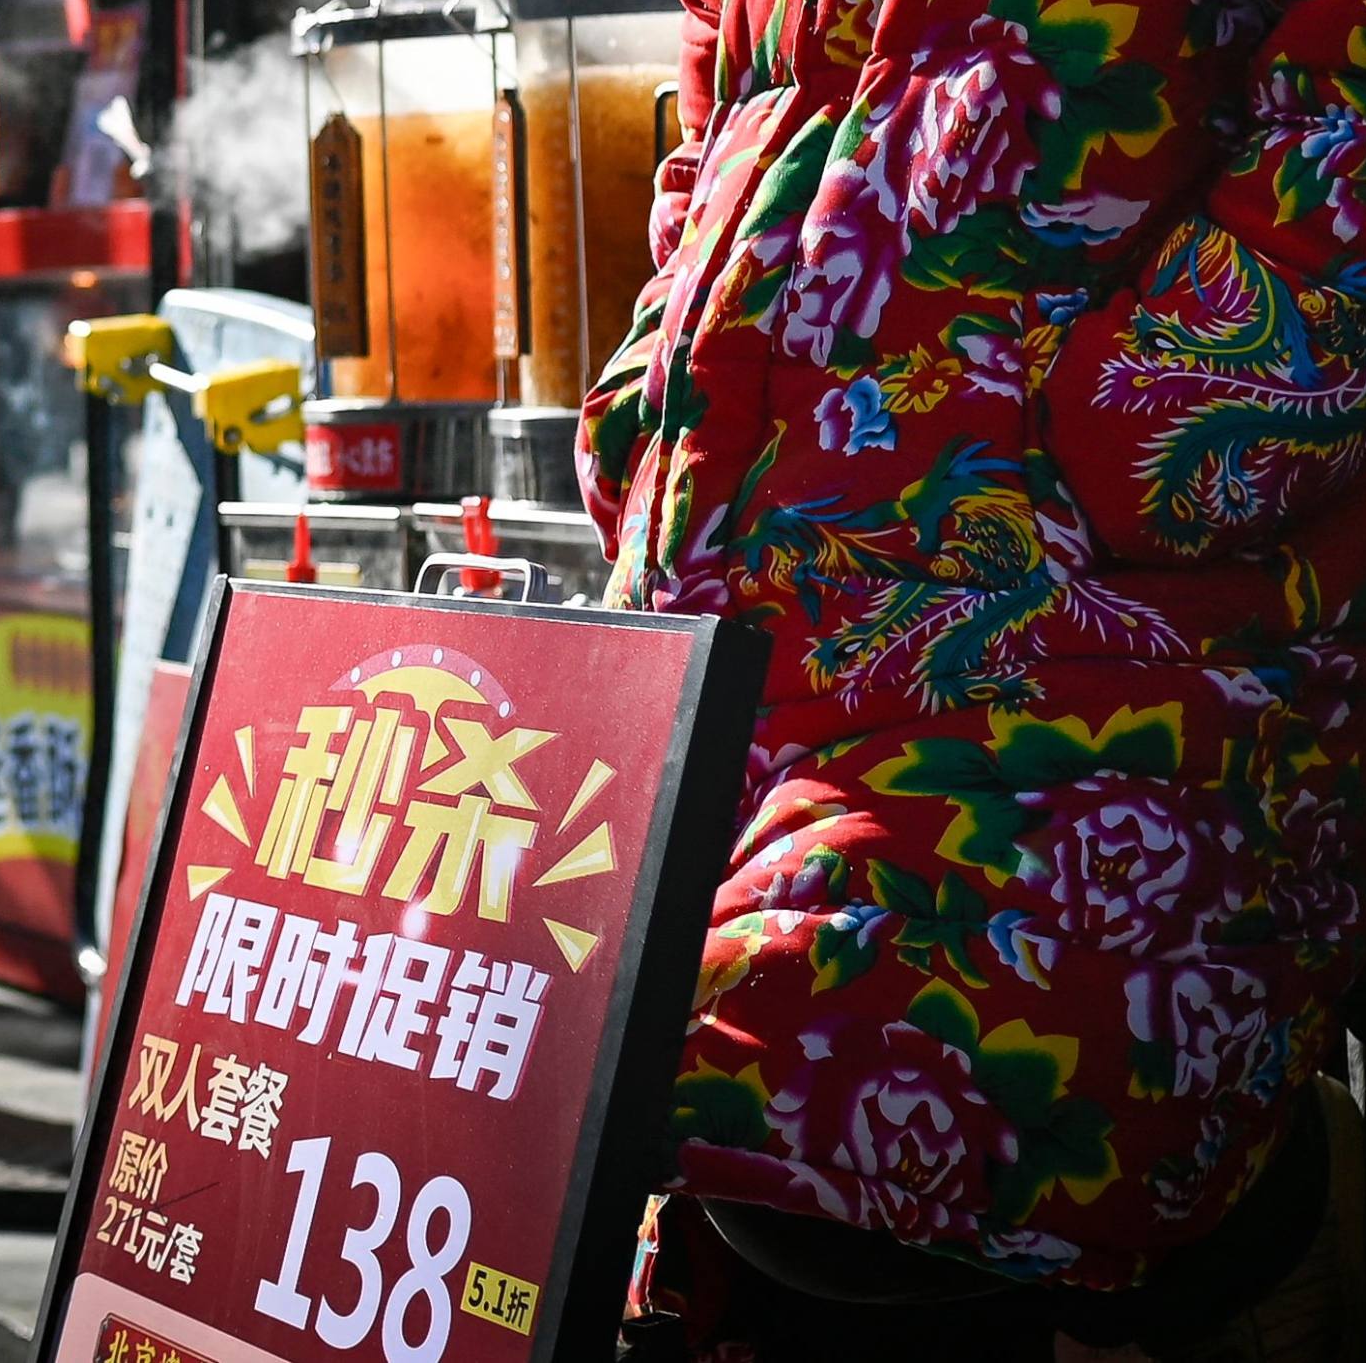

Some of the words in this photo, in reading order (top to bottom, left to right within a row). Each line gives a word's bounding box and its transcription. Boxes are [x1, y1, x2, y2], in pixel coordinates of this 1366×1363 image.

[253, 702, 559, 924] 秒杀
[175, 890, 554, 1101] 限时促销
[128, 1033, 290, 1160] 双人套餐
[108, 1129, 170, 1203] 原价
[96, 1195, 204, 1286] 271元/套
[253, 1135, 472, 1363] 138
[467, 1269, 531, 1331] 5.1折
